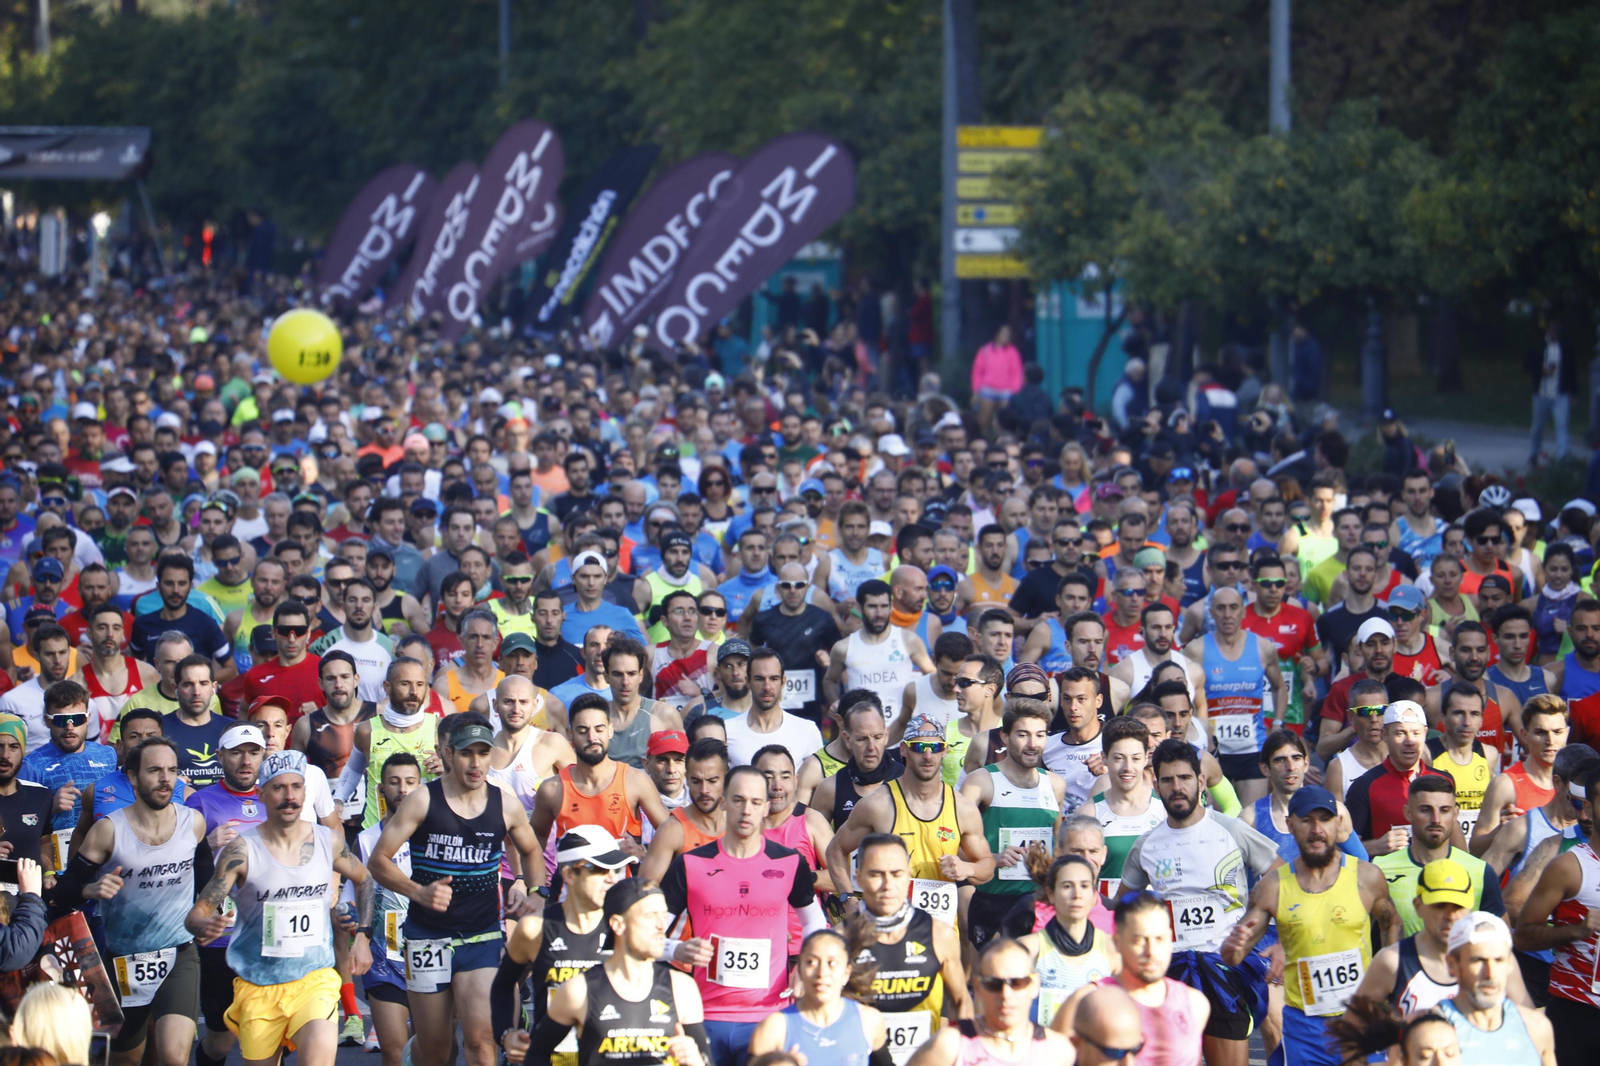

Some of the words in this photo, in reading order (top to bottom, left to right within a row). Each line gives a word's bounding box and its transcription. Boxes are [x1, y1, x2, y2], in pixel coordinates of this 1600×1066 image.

[448, 129, 553, 321] IMDECO
[656, 144, 838, 348] IMDECO
[786, 679, 809, 692] 901
[859, 671, 898, 685] INDEA
[1209, 682, 1257, 693] enerplus
[1217, 698, 1253, 706] Maratón
[1217, 725, 1250, 739] 1146
[177, 766, 225, 777] xtremadu
[1455, 790, 1485, 798] ATLETIS
[119, 868, 134, 879] LA
[137, 858, 195, 878] ANTIGRUPE
[138, 881, 154, 889] RUN
[156, 880, 164, 888] &
[256, 889, 270, 902] LA
[918, 891, 950, 910] 393
[289, 914, 311, 934] 10
[1179, 906, 1216, 926] 432
[134, 952, 158, 961] MDECO
[412, 949, 443, 969] 521
[554, 959, 572, 968] CLUB
[723, 951, 760, 970] 353
[134, 961, 168, 982] 558
[880, 969, 921, 980] DEPORTIVO
[1313, 962, 1359, 989] 1165
[870, 975, 932, 995] RUNCI
[597, 1036, 671, 1054] ARUNC
